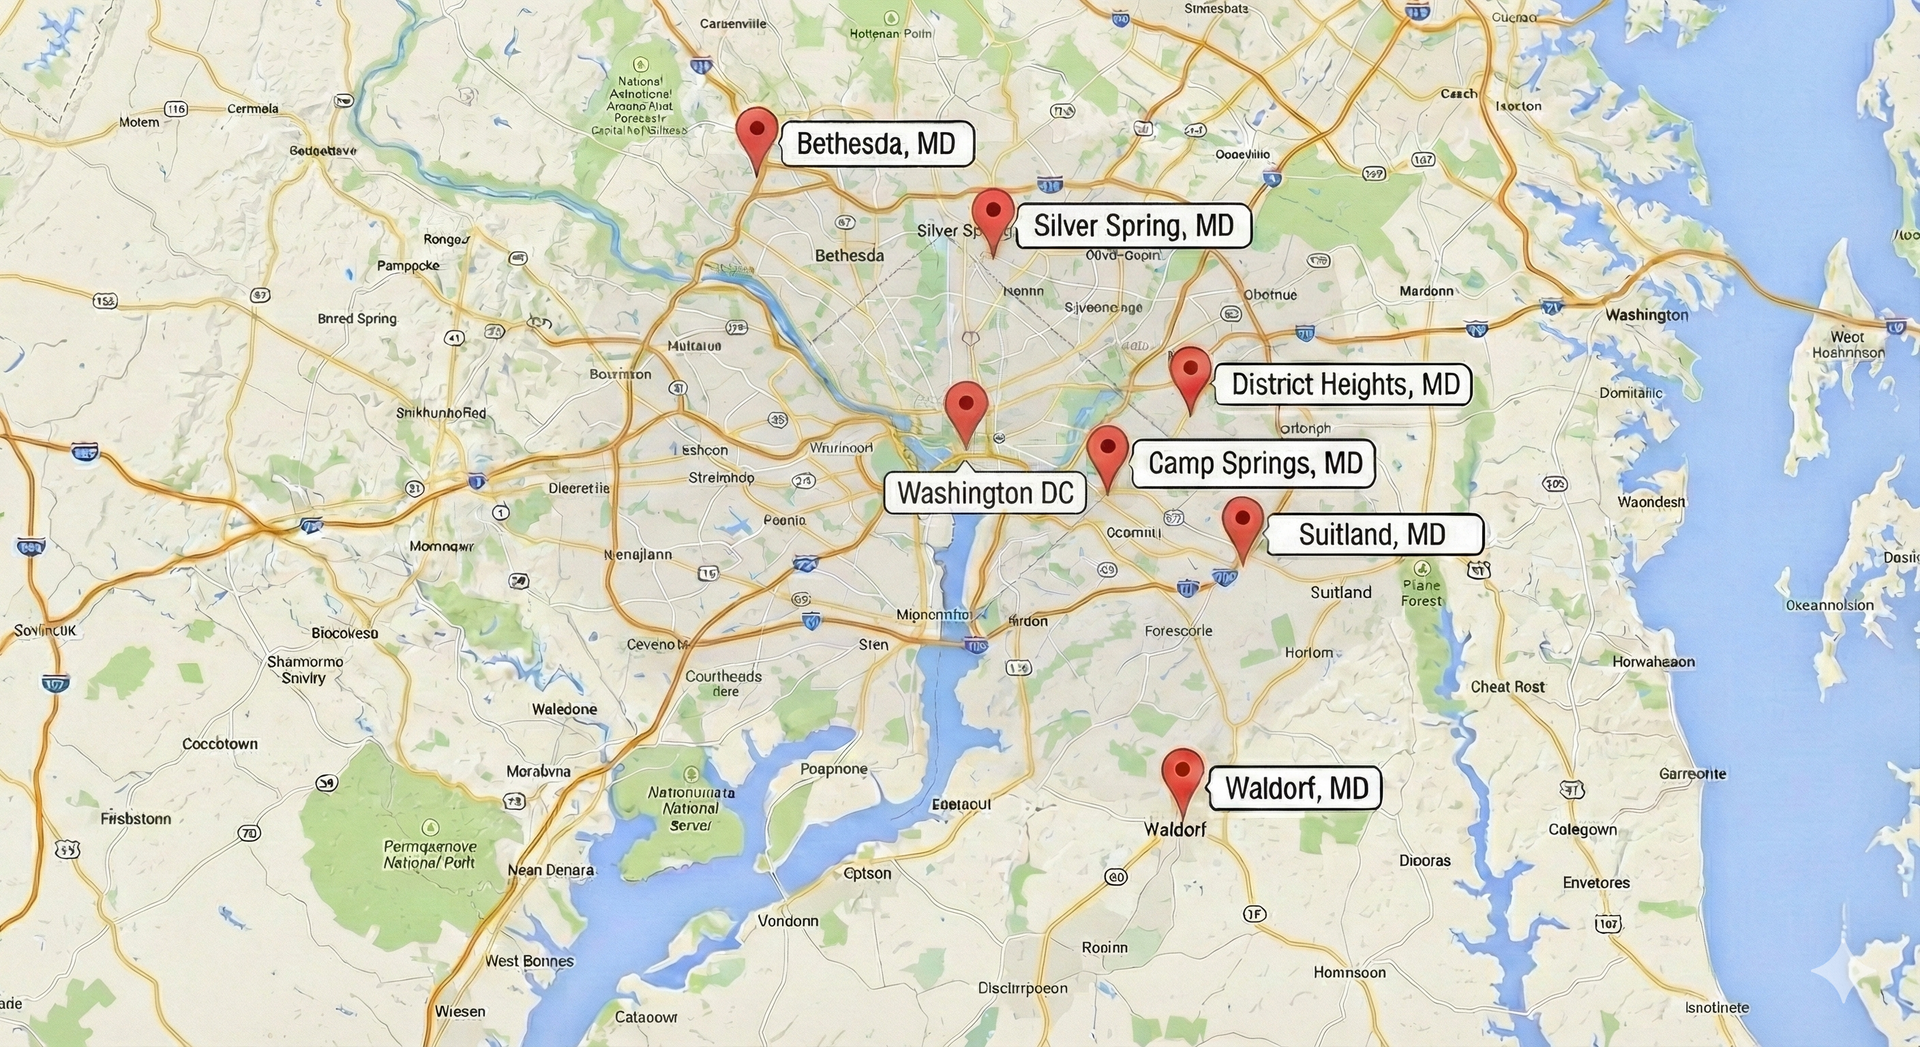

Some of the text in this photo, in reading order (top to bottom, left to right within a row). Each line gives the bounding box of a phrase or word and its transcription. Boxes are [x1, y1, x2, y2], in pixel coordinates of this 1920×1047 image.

[798, 132, 955, 158] Bethesda, MD
[918, 224, 958, 237] Silver
[1035, 214, 1233, 241] Silver Spring, MD
[816, 248, 884, 262] Bethesda
[1401, 286, 1453, 296] Mardonn
[358, 313, 396, 326] Spring
[1606, 309, 1688, 324] Washington
[1234, 372, 1459, 400] District Heights, MD
[1150, 451, 1362, 479] Camp Springs, MD
[898, 481, 1073, 509] Washington DC
[1300, 523, 1445, 549] Suitland, MD
[1312, 586, 1371, 598] Suitland
[1402, 596, 1442, 606] Forest
[1472, 681, 1545, 693] Cheat Rost
[1226, 776, 1368, 803] Waldorf, MD
[663, 802, 718, 814] National
[1144, 820, 1206, 837] Waldorf
[509, 864, 594, 875] Nean Denara
[1564, 876, 1630, 888] Envetores
[486, 955, 518, 967] West
[435, 1005, 485, 1017] Wiesen
